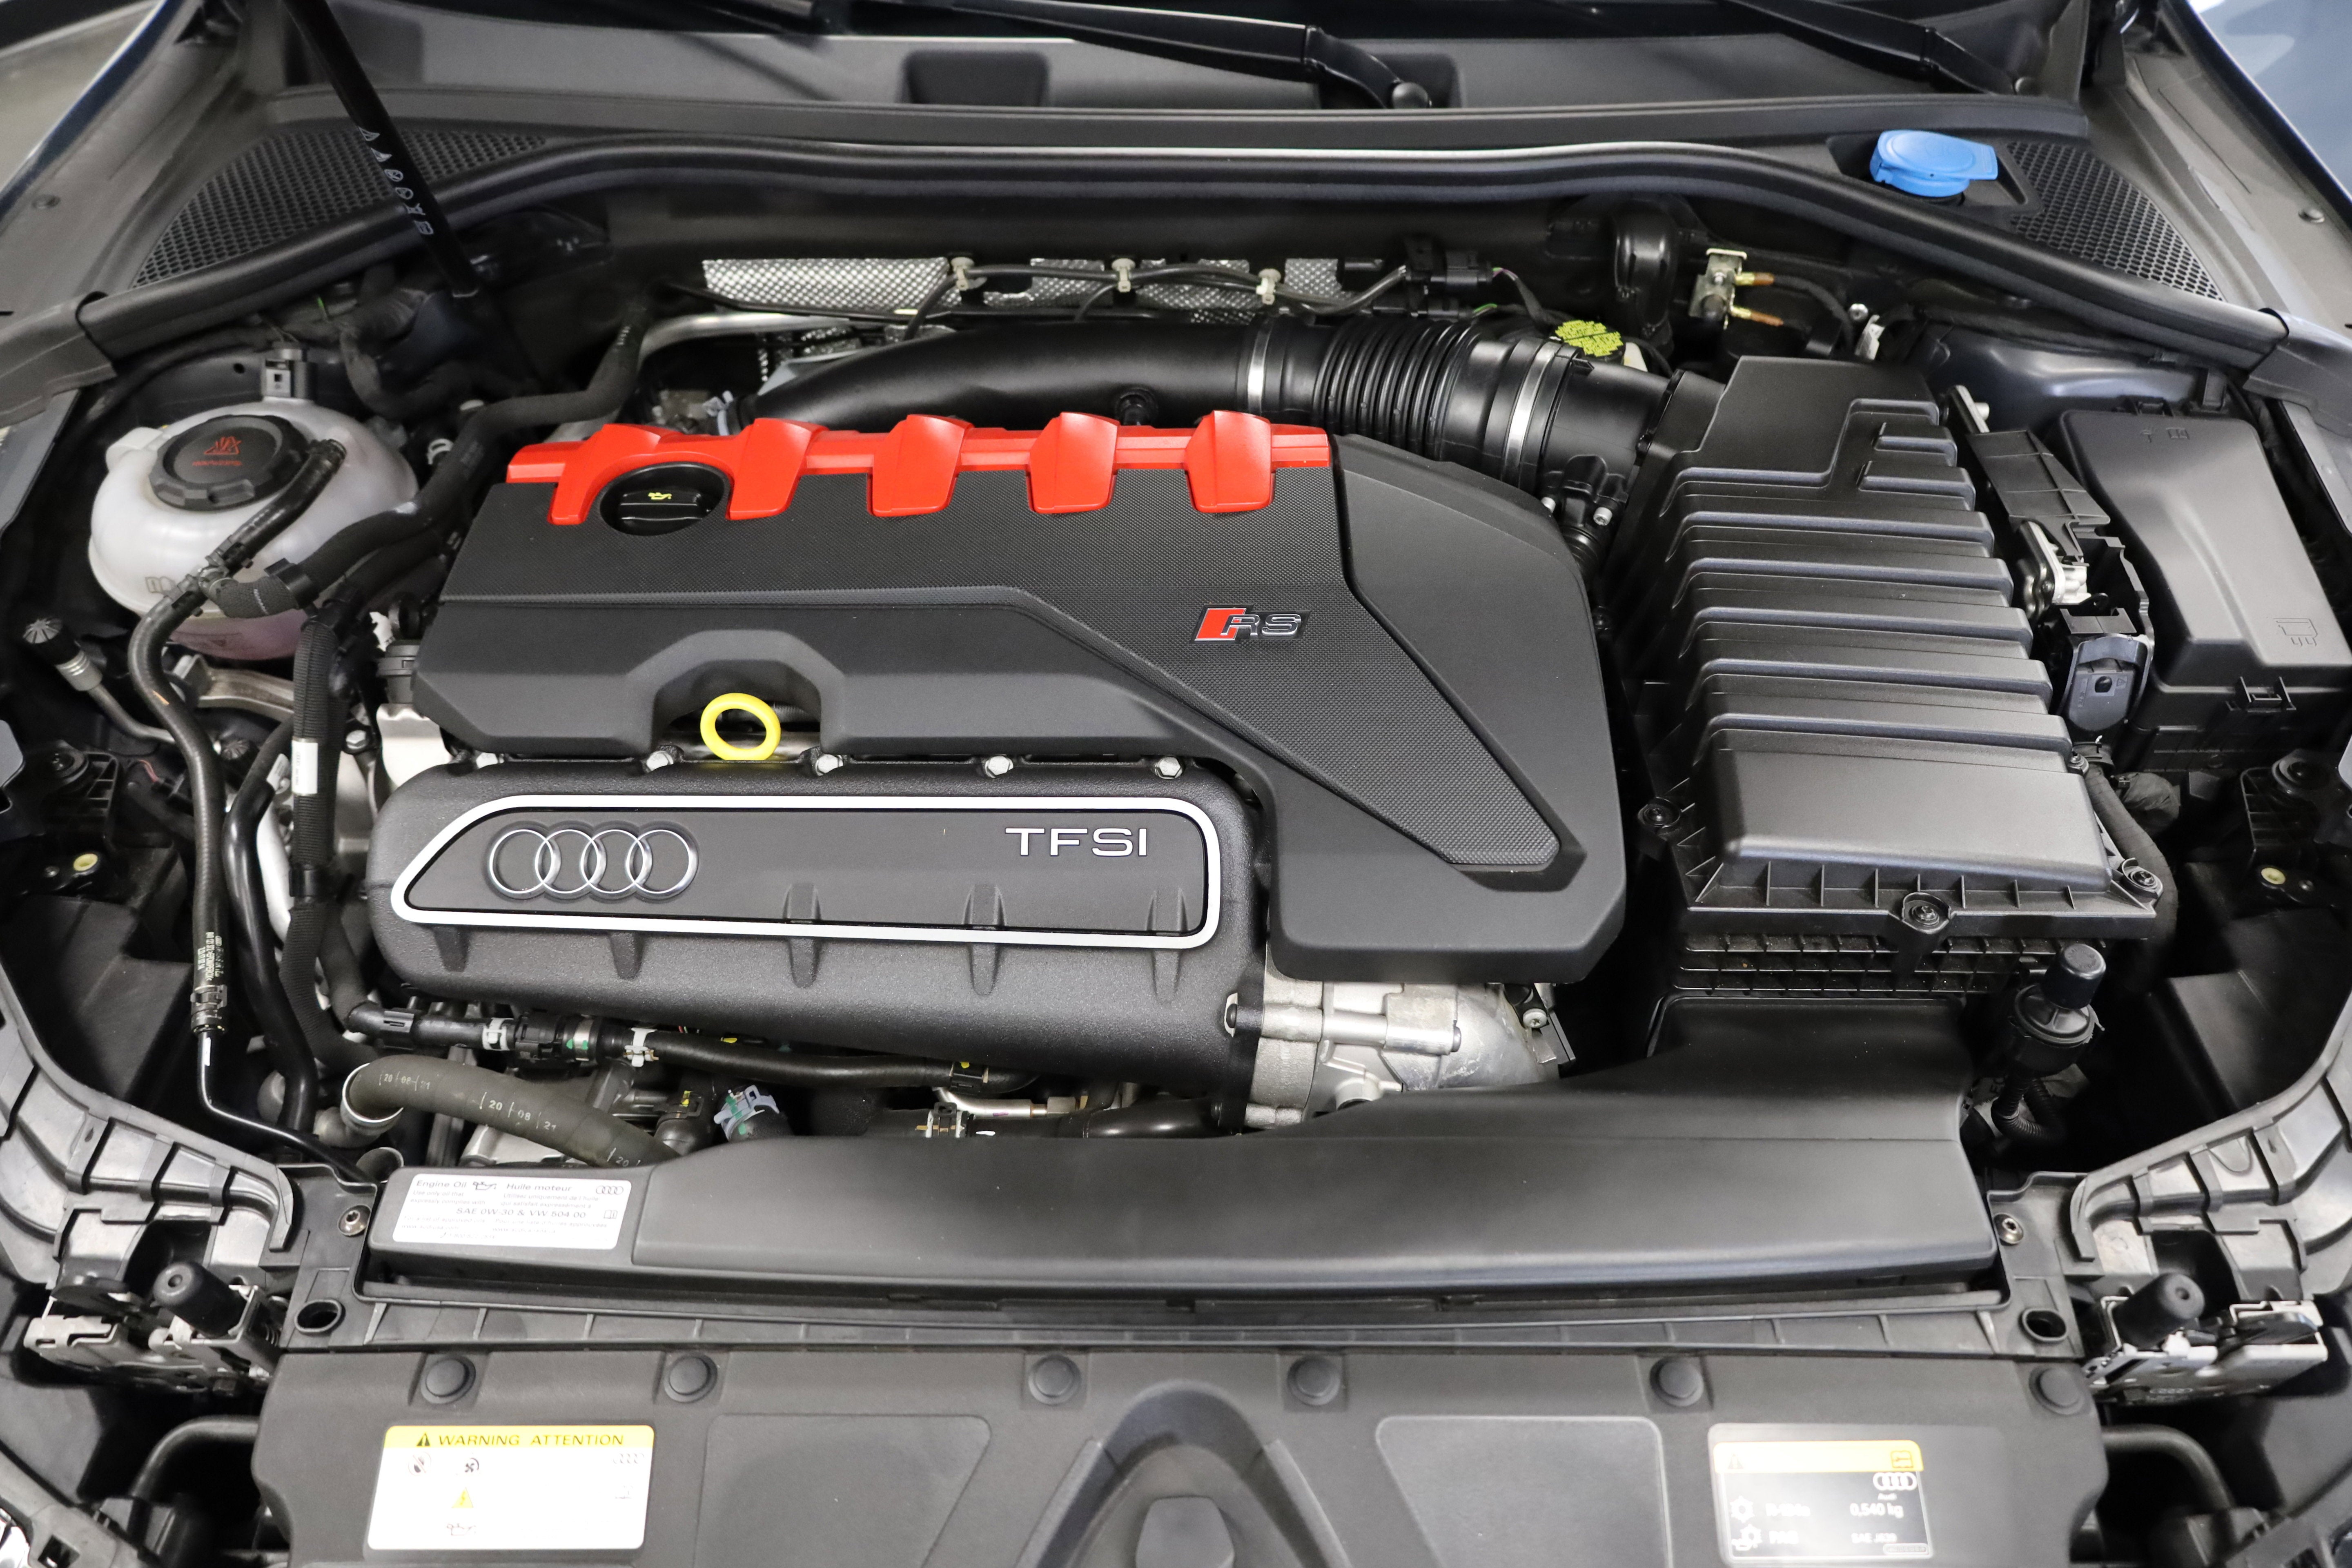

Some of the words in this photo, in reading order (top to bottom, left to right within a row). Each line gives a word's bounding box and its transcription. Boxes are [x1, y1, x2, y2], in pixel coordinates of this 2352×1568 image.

[1220, 614, 1301, 637] RS
[1005, 828, 1147, 856] TFSI
[489, 1100, 503, 1111] 20
[518, 1109, 531, 1121] 08
[616, 1156, 629, 1167] 20
[416, 1180, 450, 1188] Engine
[439, 1434, 521, 1446] WARNING
[530, 1434, 624, 1446] ATTENTION
